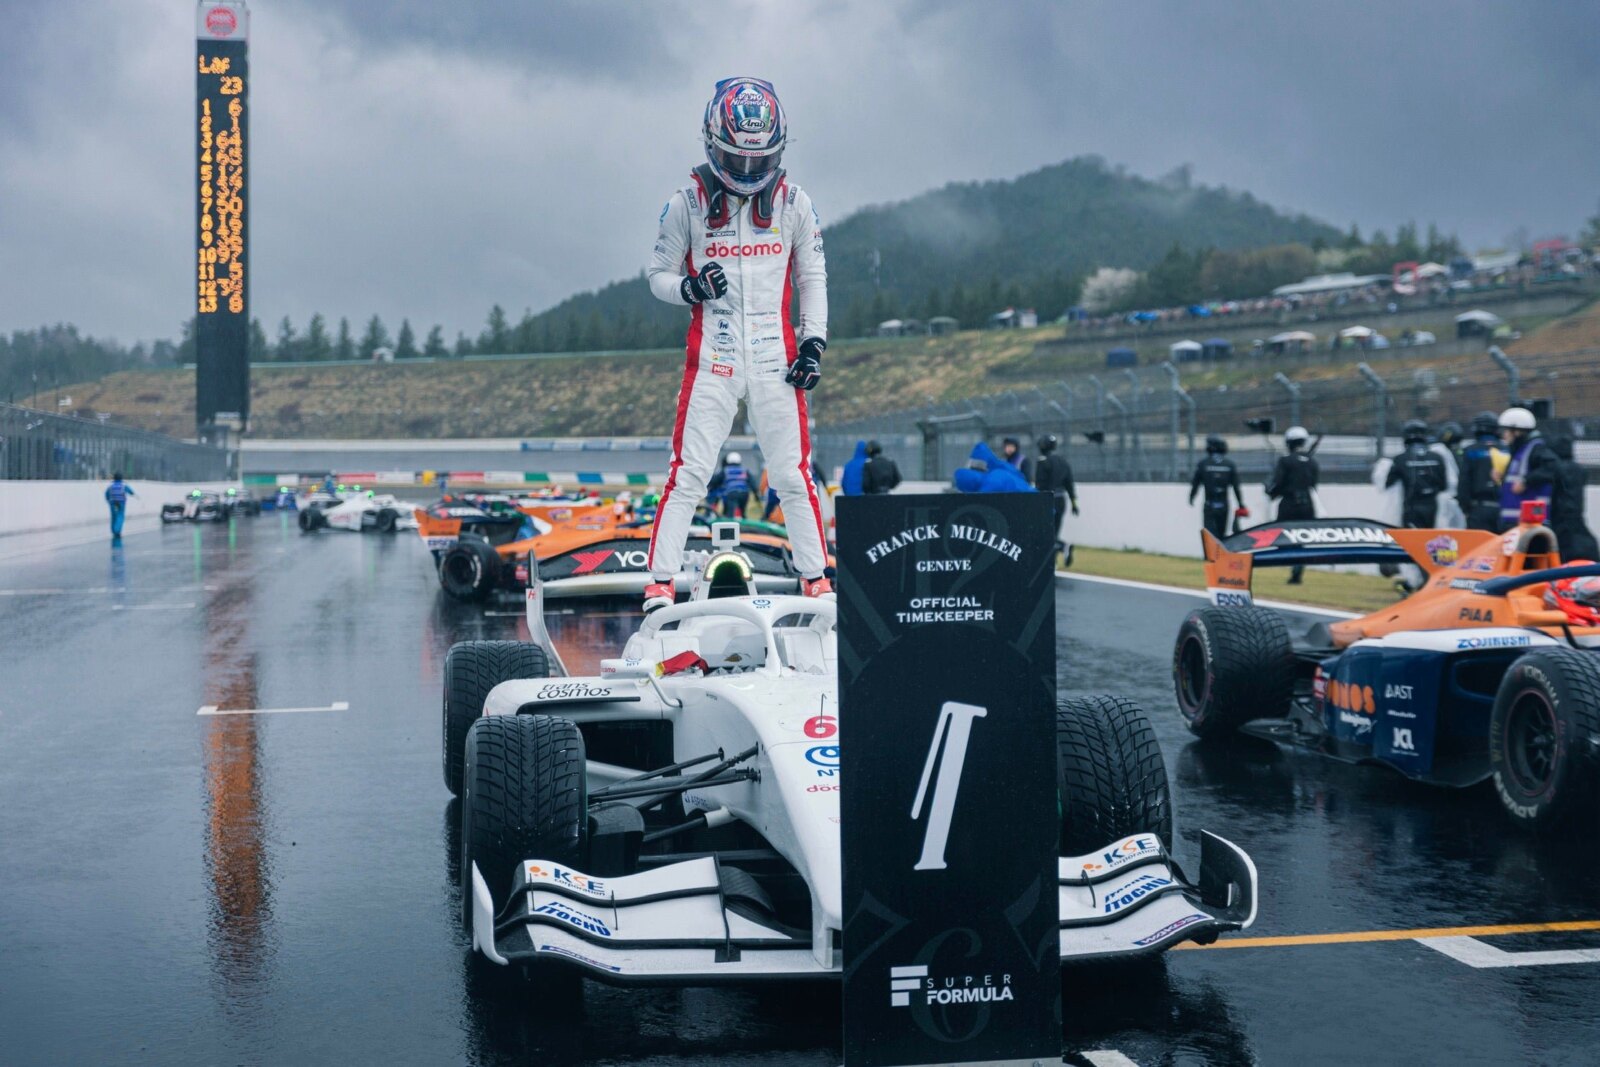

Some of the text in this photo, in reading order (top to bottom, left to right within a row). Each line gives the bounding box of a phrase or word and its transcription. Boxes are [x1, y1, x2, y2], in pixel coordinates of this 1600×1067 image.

[220, 76, 243, 94] 23
[202, 97, 243, 117] 1 6
[200, 115, 213, 132] 2
[743, 120, 763, 128] Arai
[201, 148, 213, 164] 4
[200, 164, 213, 181] 5
[200, 181, 213, 198] 6
[200, 197, 213, 214] 7
[200, 213, 213, 231] 8
[201, 230, 213, 247] 9
[705, 243, 783, 258] docomo
[713, 365, 732, 374] NGK
[865, 524, 1023, 564] FRANCK MULLER
[1282, 527, 1394, 544] YOKOHAMA
[916, 560, 972, 572] GENEVE
[910, 596, 981, 609] OFFICIAL
[897, 610, 994, 623] TIMEKEEPER
[1459, 607, 1493, 623] PIAA
[1456, 635, 1531, 649] ZOJIRUSHI
[537, 687, 612, 699] cosmos
[803, 715, 838, 739] 6
[806, 785, 840, 793] doc
[910, 701, 988, 871] 1
[1104, 877, 1173, 914] ITOCHU
[532, 904, 612, 937] ITOCHU
[926, 974, 1011, 989] SUPER
[927, 986, 1014, 1005] FORMULA
